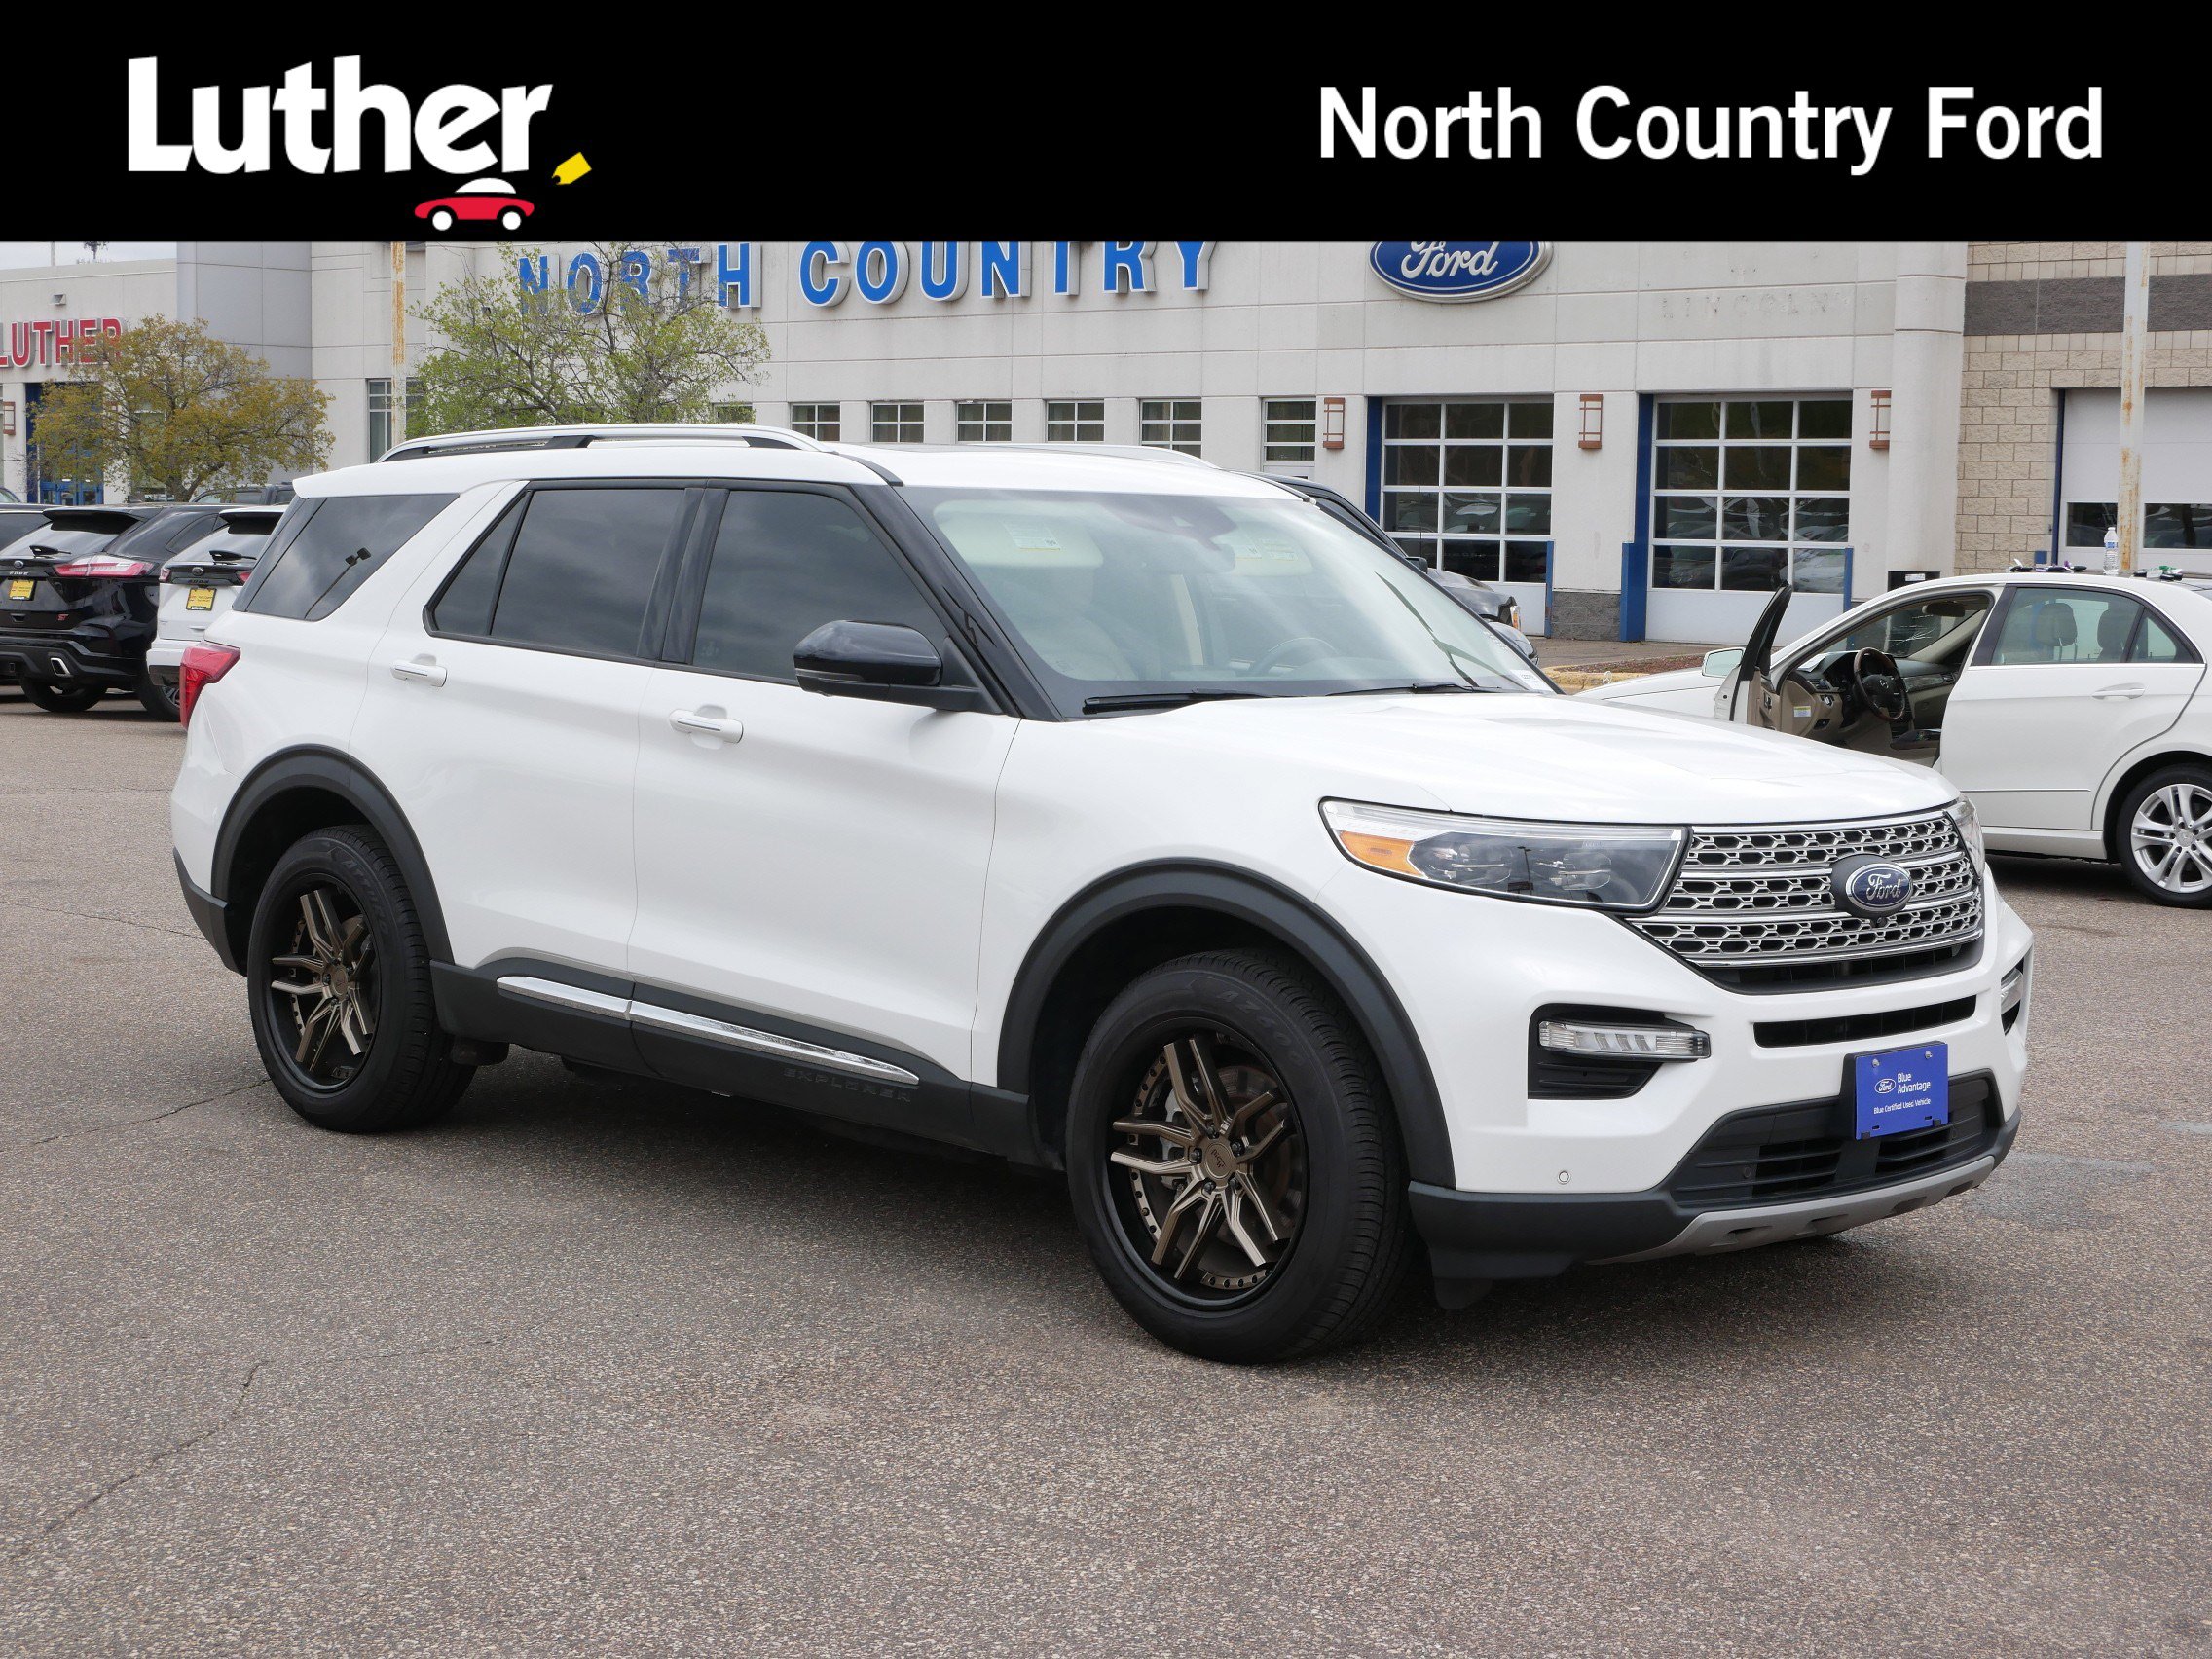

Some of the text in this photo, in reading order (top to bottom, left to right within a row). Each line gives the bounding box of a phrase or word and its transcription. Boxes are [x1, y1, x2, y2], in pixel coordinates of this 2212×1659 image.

[1400, 241, 1499, 279] Ford
[518, 242, 754, 316] NORTH
[1865, 873, 1901, 901] Ford
[782, 1067, 912, 1103] EXPLORER
[1878, 1080, 1892, 1092] Ford
[1897, 1072, 1911, 1083] Blue
[1897, 1081, 1931, 1094] Advantage
[1884, 1101, 1901, 1112] Certified
[1902, 1100, 1913, 1109] Used
[1914, 1097, 1931, 1107] Vehicle
